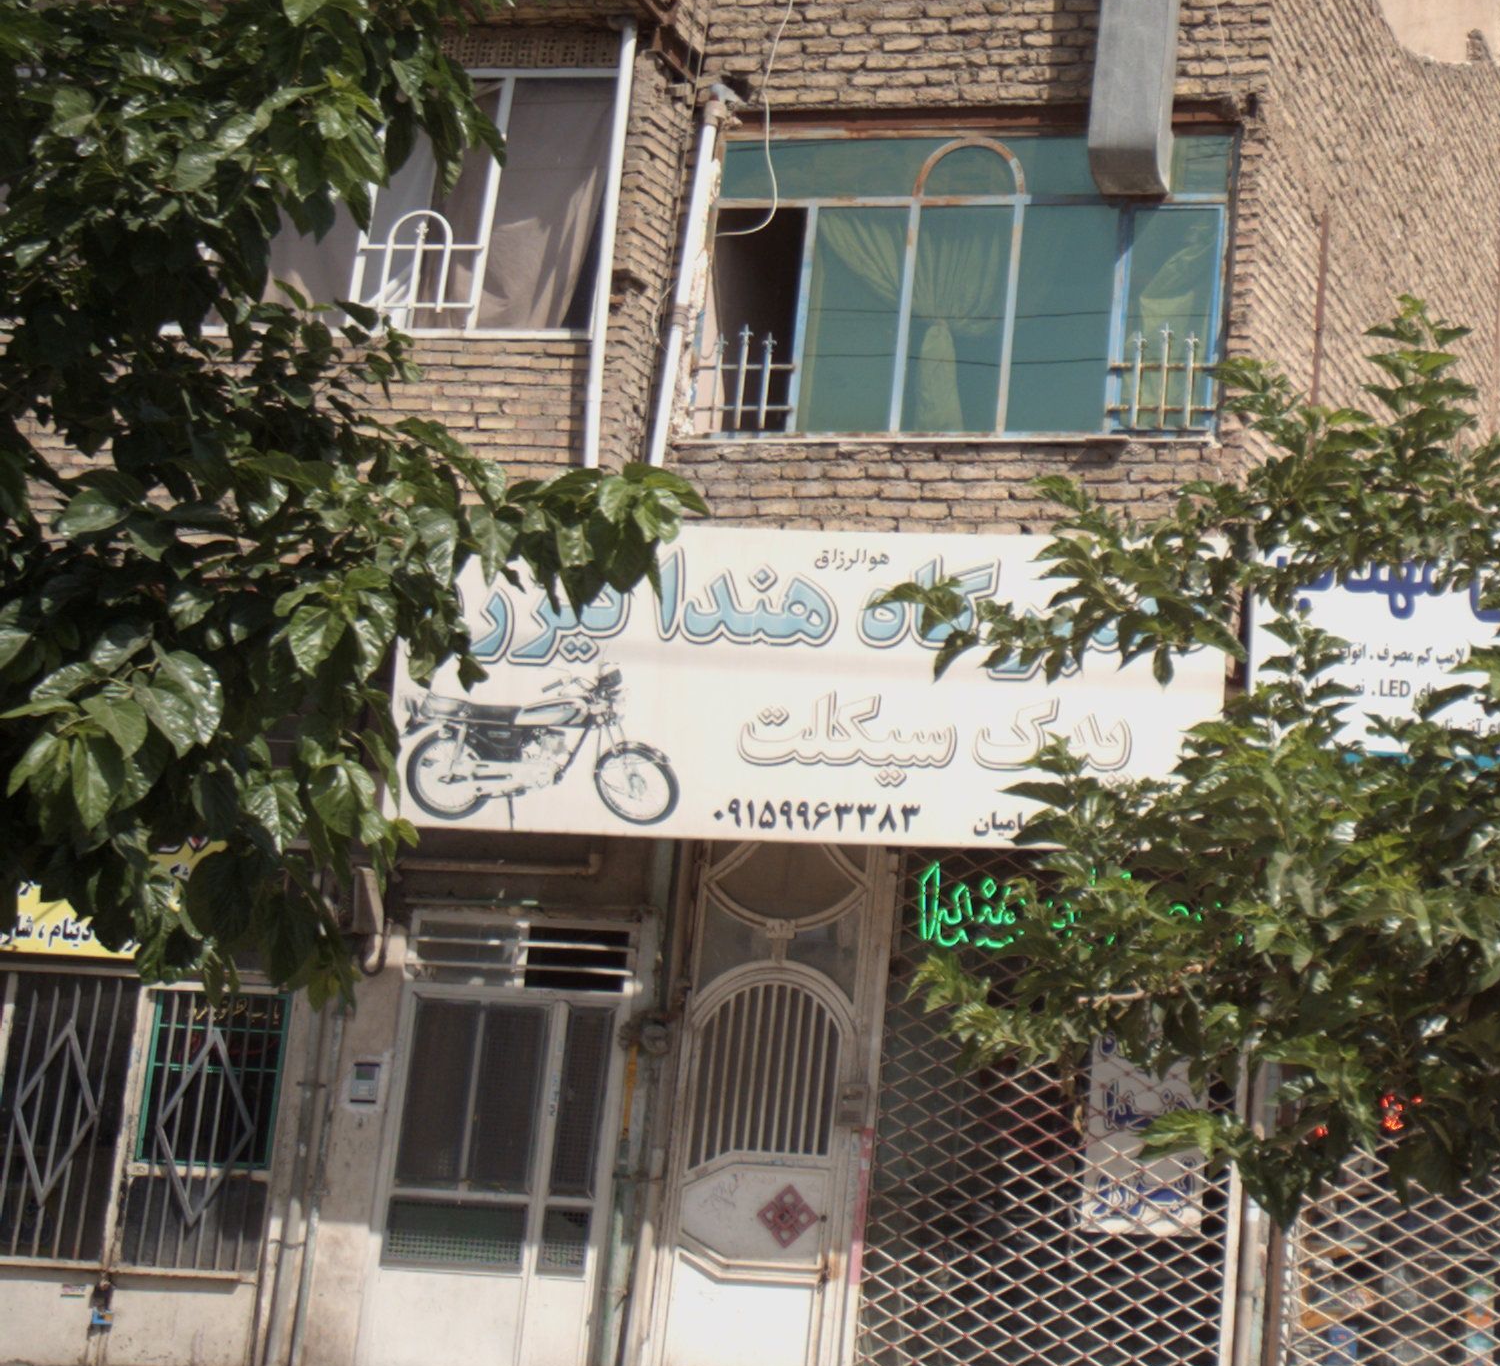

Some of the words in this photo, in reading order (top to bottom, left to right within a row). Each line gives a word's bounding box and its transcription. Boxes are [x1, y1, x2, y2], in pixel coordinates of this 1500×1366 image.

[652, 546, 839, 647] هندا
[1379, 679, 1411, 697] LED
[737, 690, 957, 787] سیکلت
[972, 697, 1132, 788] یدک
[713, 797, 922, 833] ۰۹۱۵۹۹۶۳۳۸۳
